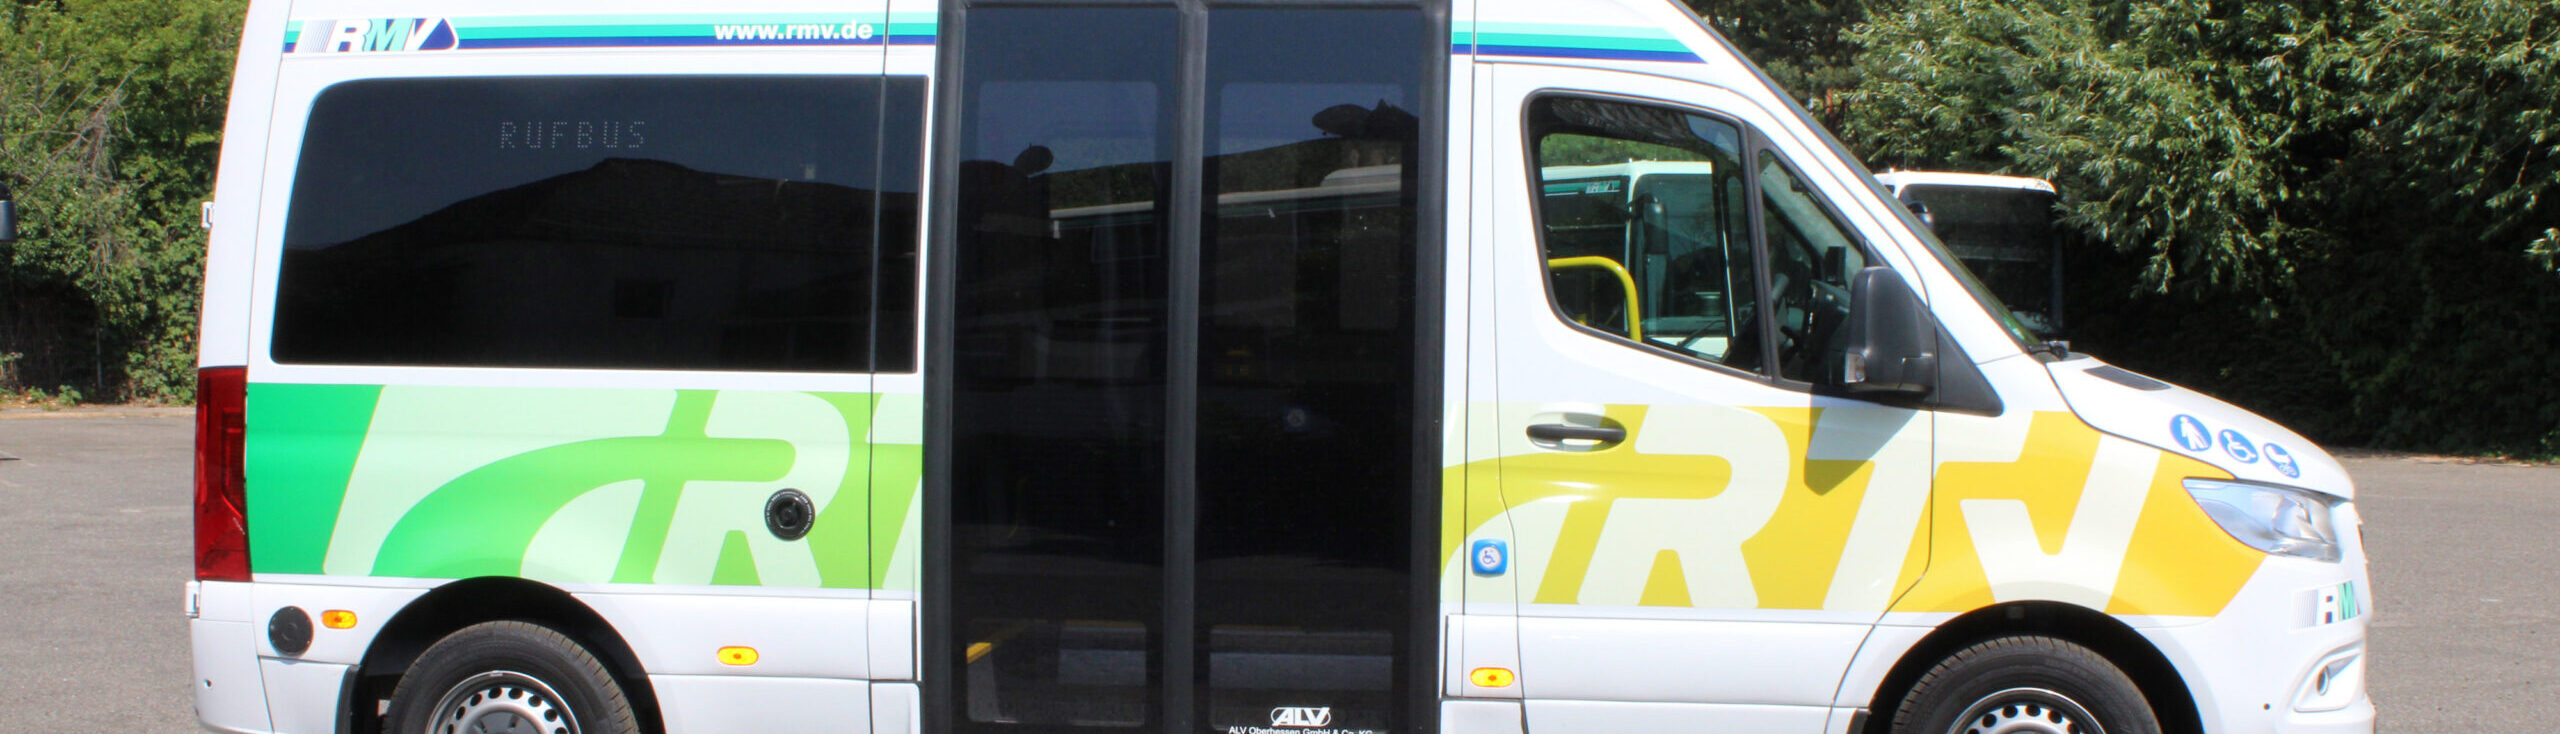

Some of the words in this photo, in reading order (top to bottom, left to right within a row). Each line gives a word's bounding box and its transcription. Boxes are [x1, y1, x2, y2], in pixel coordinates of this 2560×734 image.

[325, 18, 444, 52] RMV
[714, 20, 874, 40] www.rmv.de
[500, 121, 646, 149] RUFBUS
[2314, 580, 2362, 626] RM
[1272, 707, 1330, 726] ALV
[1228, 726, 1247, 734] ALV
